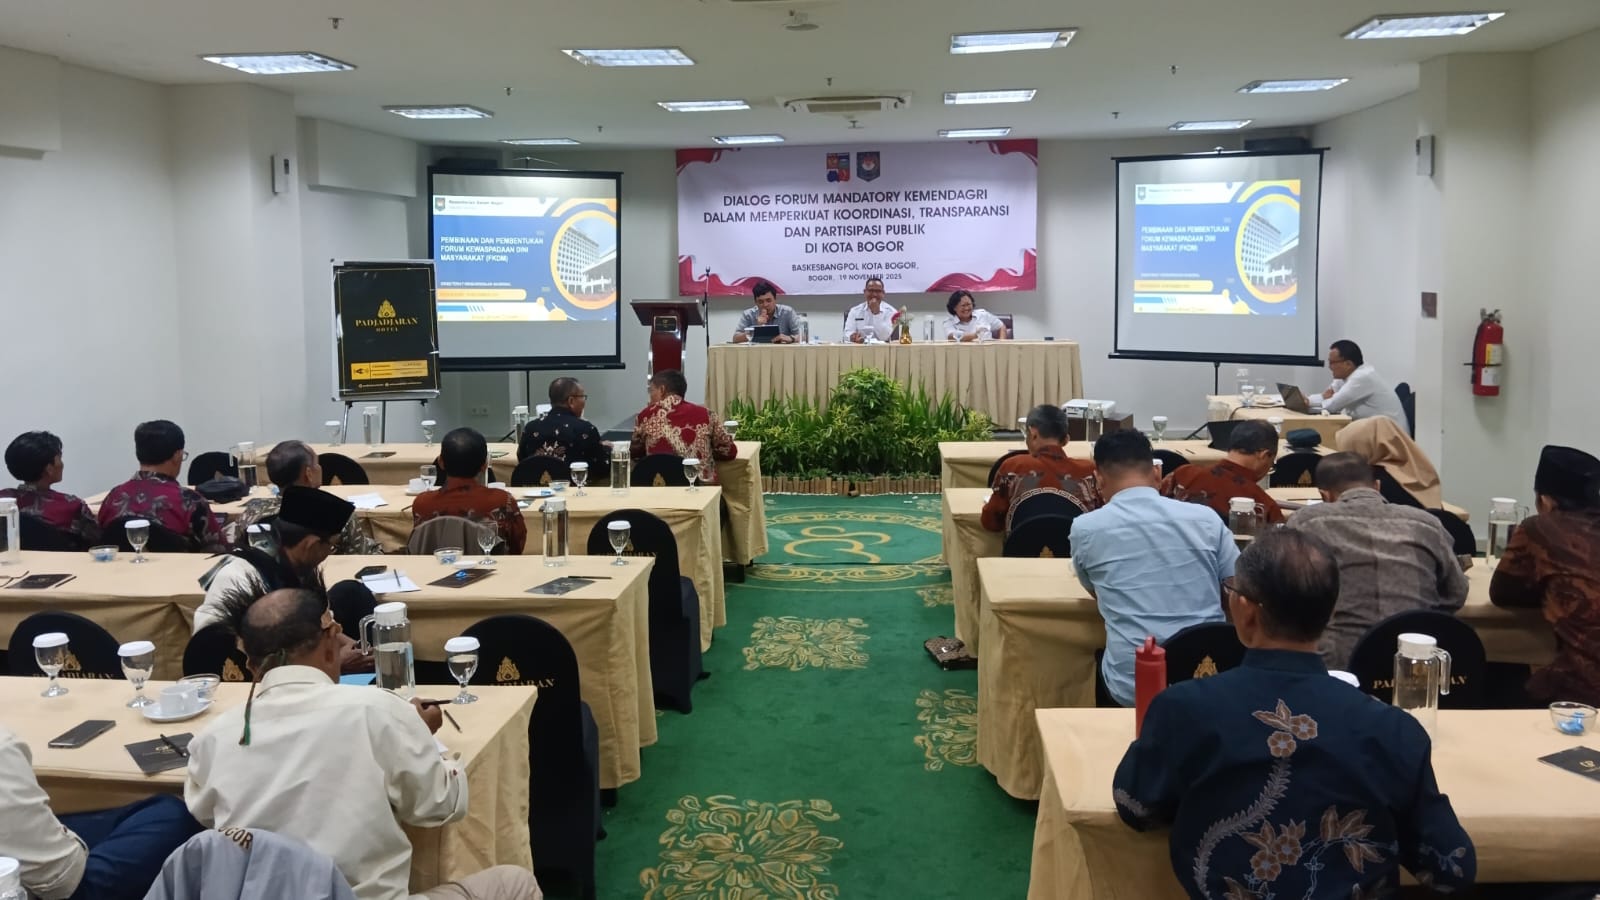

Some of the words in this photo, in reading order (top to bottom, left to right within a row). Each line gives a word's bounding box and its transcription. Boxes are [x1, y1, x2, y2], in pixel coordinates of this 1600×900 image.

[723, 195, 771, 206] DIALOG
[775, 193, 818, 205] FORUM
[823, 191, 900, 204] MANDATORY
[904, 189, 988, 202] KEMENDAGRI
[704, 212, 746, 223] DALAM
[750, 209, 829, 222] MEMPERKUAT
[834, 207, 915, 220] KOORDINASI,
[920, 205, 1009, 217] TRANSPARANSI
[784, 227, 810, 238] DAN
[815, 225, 881, 237] PARTISIPASI
[886, 223, 925, 235] PUBLIK
[440, 236, 479, 244] PEMBINAAN
[496, 237, 543, 245] PEMBENTUKAN
[805, 243, 817, 253] DI
[822, 242, 853, 253] KOTA
[857, 241, 904, 252] BOGOR
[792, 263, 859, 272] BASKESBANGPOL
[861, 262, 883, 270] KOTA
[355, 317, 418, 327] PADJADJARAN
